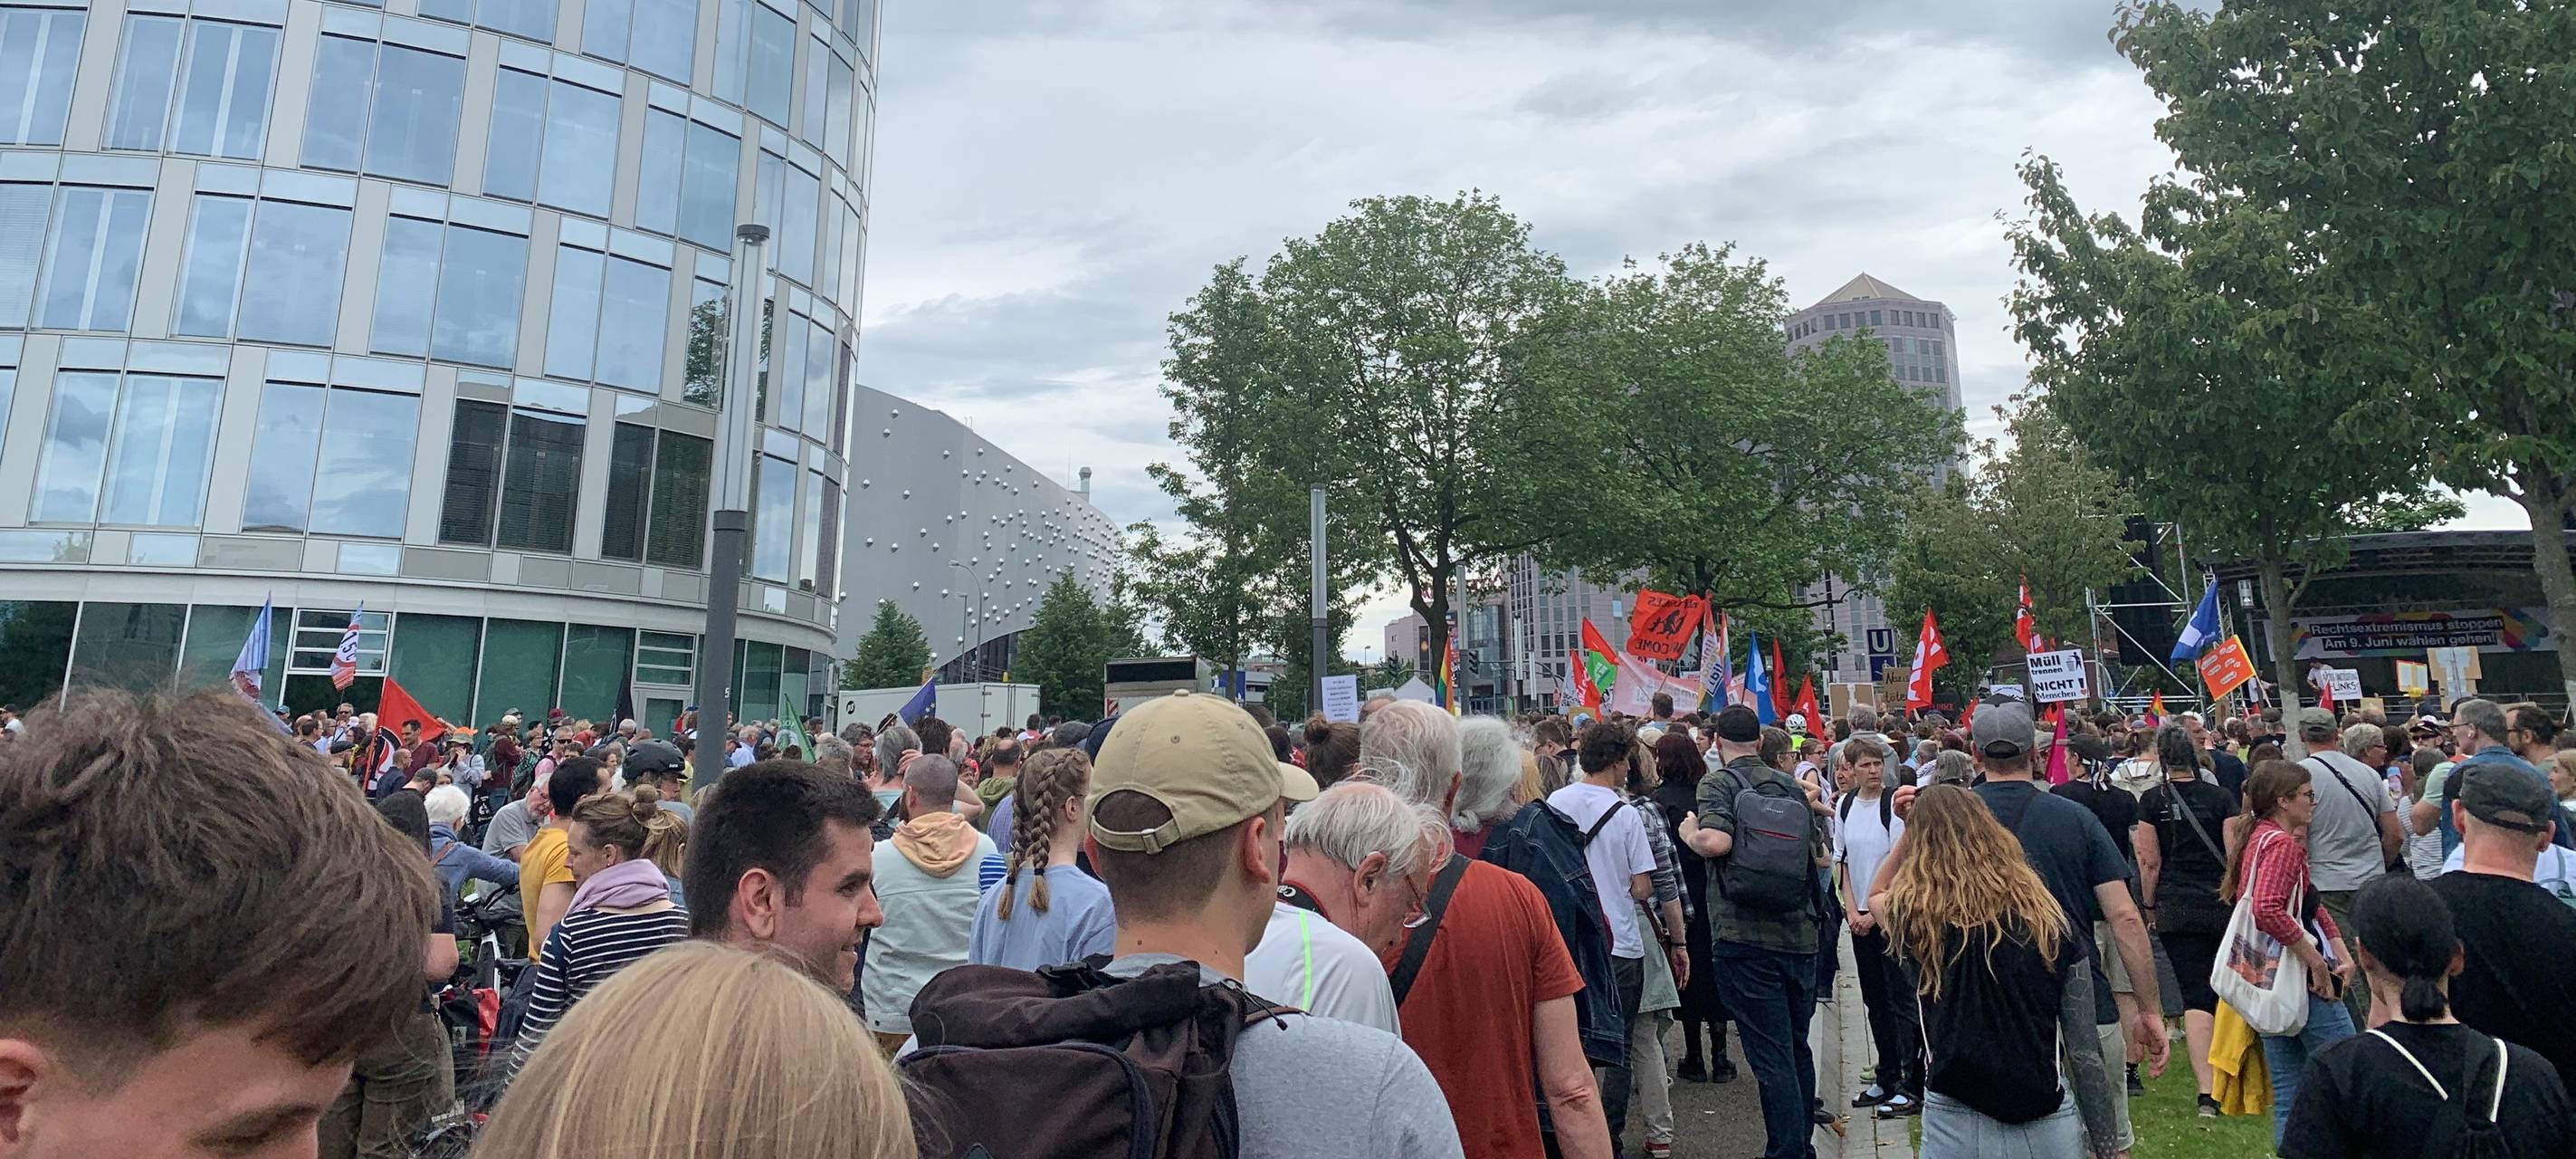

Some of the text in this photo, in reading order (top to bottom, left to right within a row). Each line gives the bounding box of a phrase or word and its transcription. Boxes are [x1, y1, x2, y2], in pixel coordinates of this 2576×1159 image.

[2311, 618, 2504, 635] Rechtsextremismus stoppen
[1871, 631, 1890, 652] U
[2324, 632, 2495, 649] Am 9. Juni wählen gehen!
[2029, 655, 2061, 668] Müll
[2035, 679, 2074, 692] NICHT
[2037, 691, 2076, 699] Menschen
